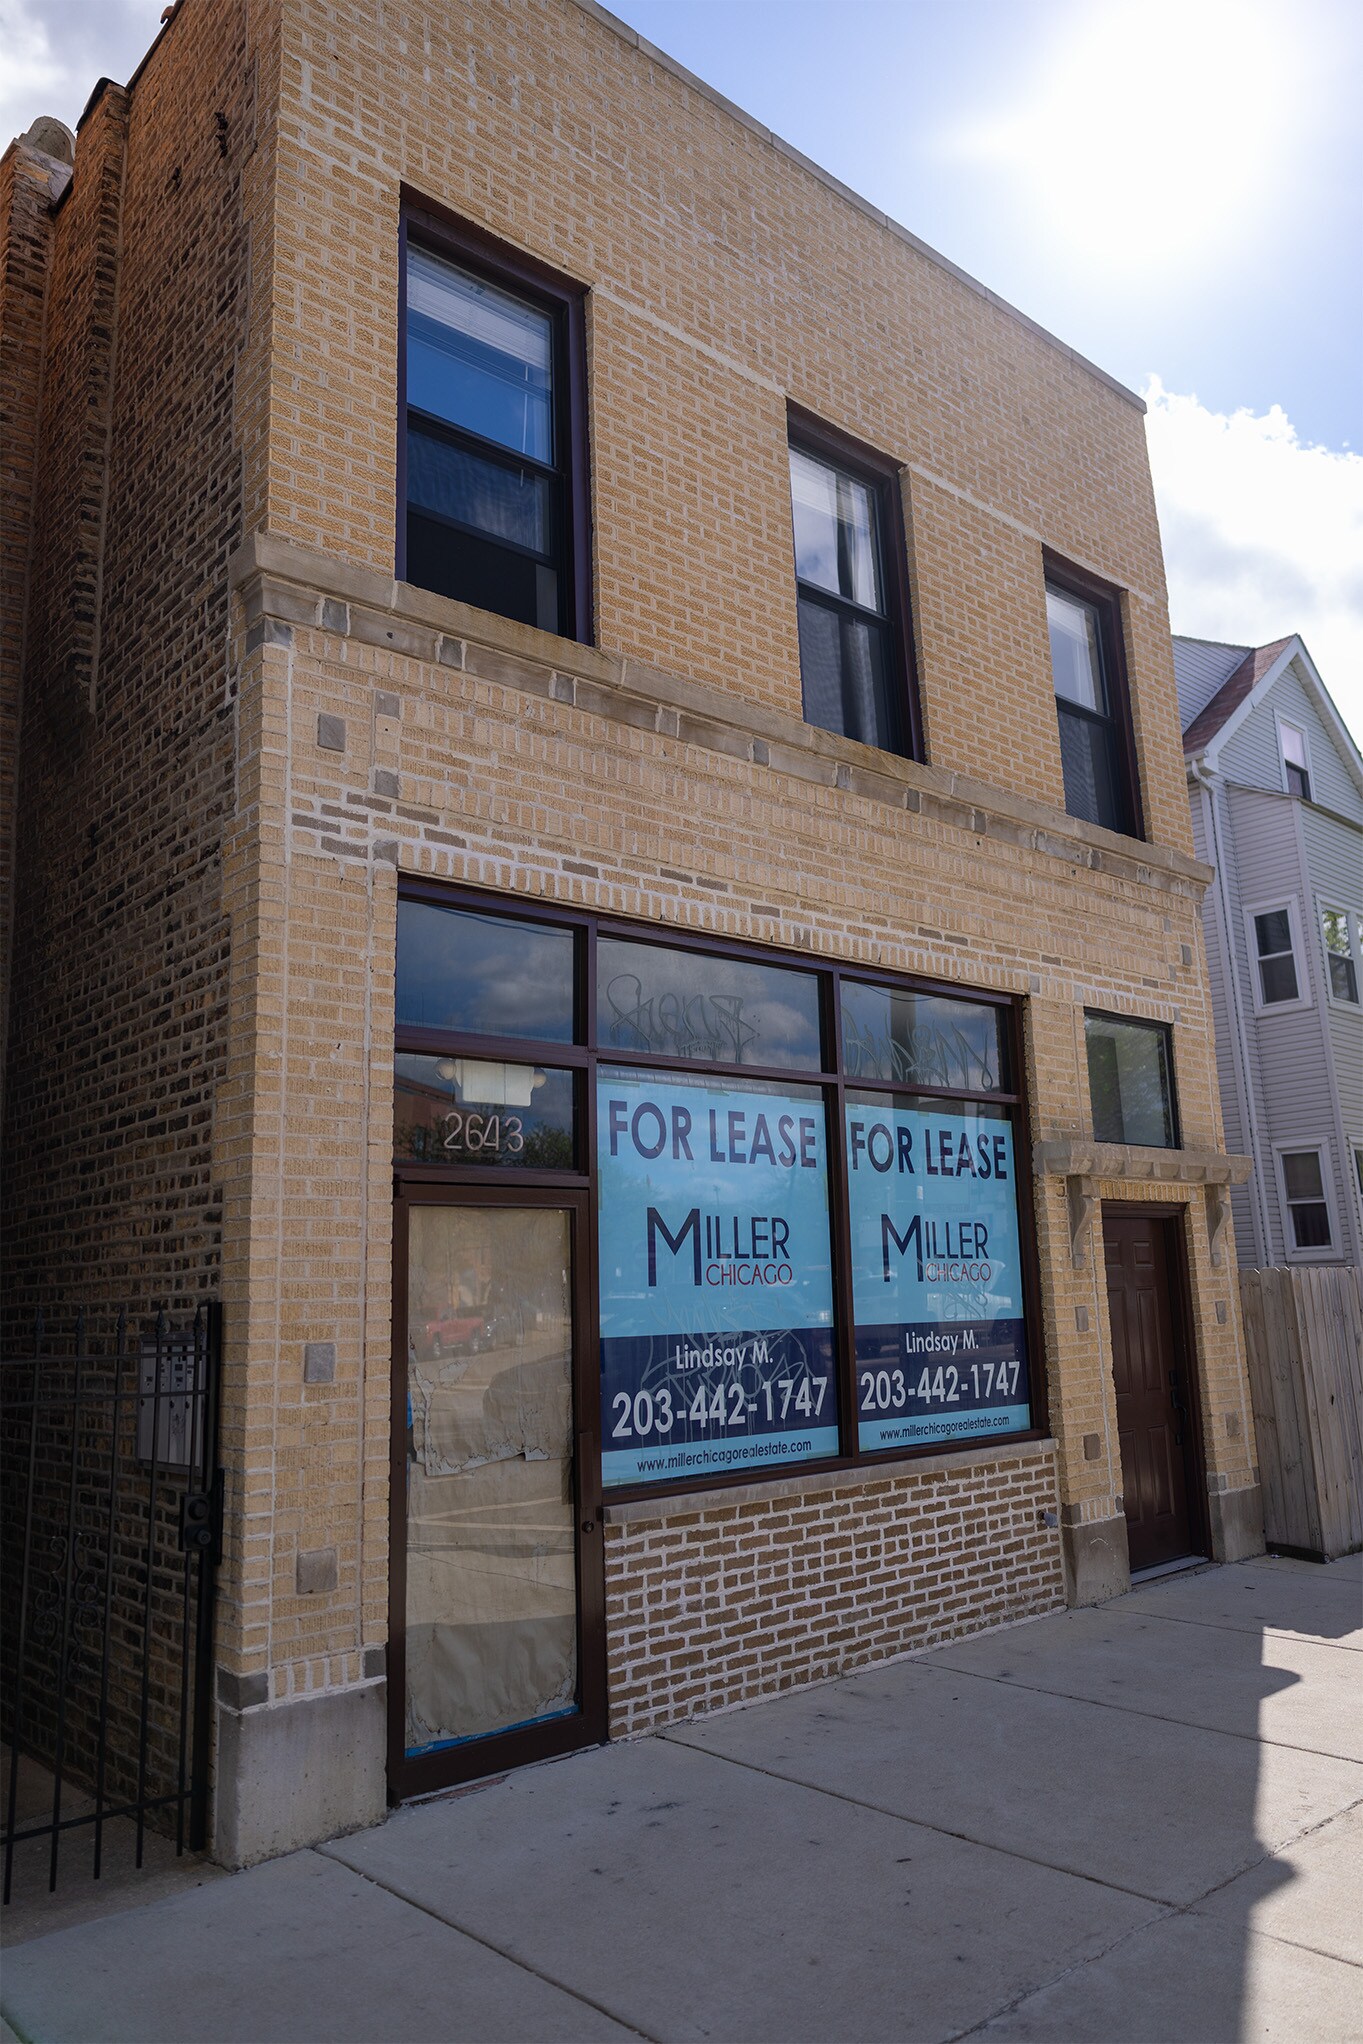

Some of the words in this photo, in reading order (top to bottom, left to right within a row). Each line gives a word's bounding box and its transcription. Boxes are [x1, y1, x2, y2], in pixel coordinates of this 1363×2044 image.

[444, 1112, 524, 1152] 2643
[609, 1100, 694, 1160] FOR
[709, 1109, 817, 1168] LEASE
[850, 1122, 915, 1174] FOR
[925, 1129, 1008, 1180] LEASE
[647, 1207, 790, 1287] MILLER
[881, 1214, 989, 1282] MILLER
[706, 1263, 793, 1286] CHICAGO
[926, 1263, 992, 1282] CHICAGO
[675, 1343, 746, 1370] Lindsay
[752, 1341, 774, 1364] M.
[906, 1331, 958, 1355] Lindsay
[963, 1329, 979, 1350] M.
[860, 1361, 1020, 1411] 203-442-1747
[611, 1376, 828, 1438] 203-442-1747
[880, 1415, 1010, 1440] www.millerchicagorealestate.com
[637, 1439, 812, 1473] www.millerchicagorealestate.com
